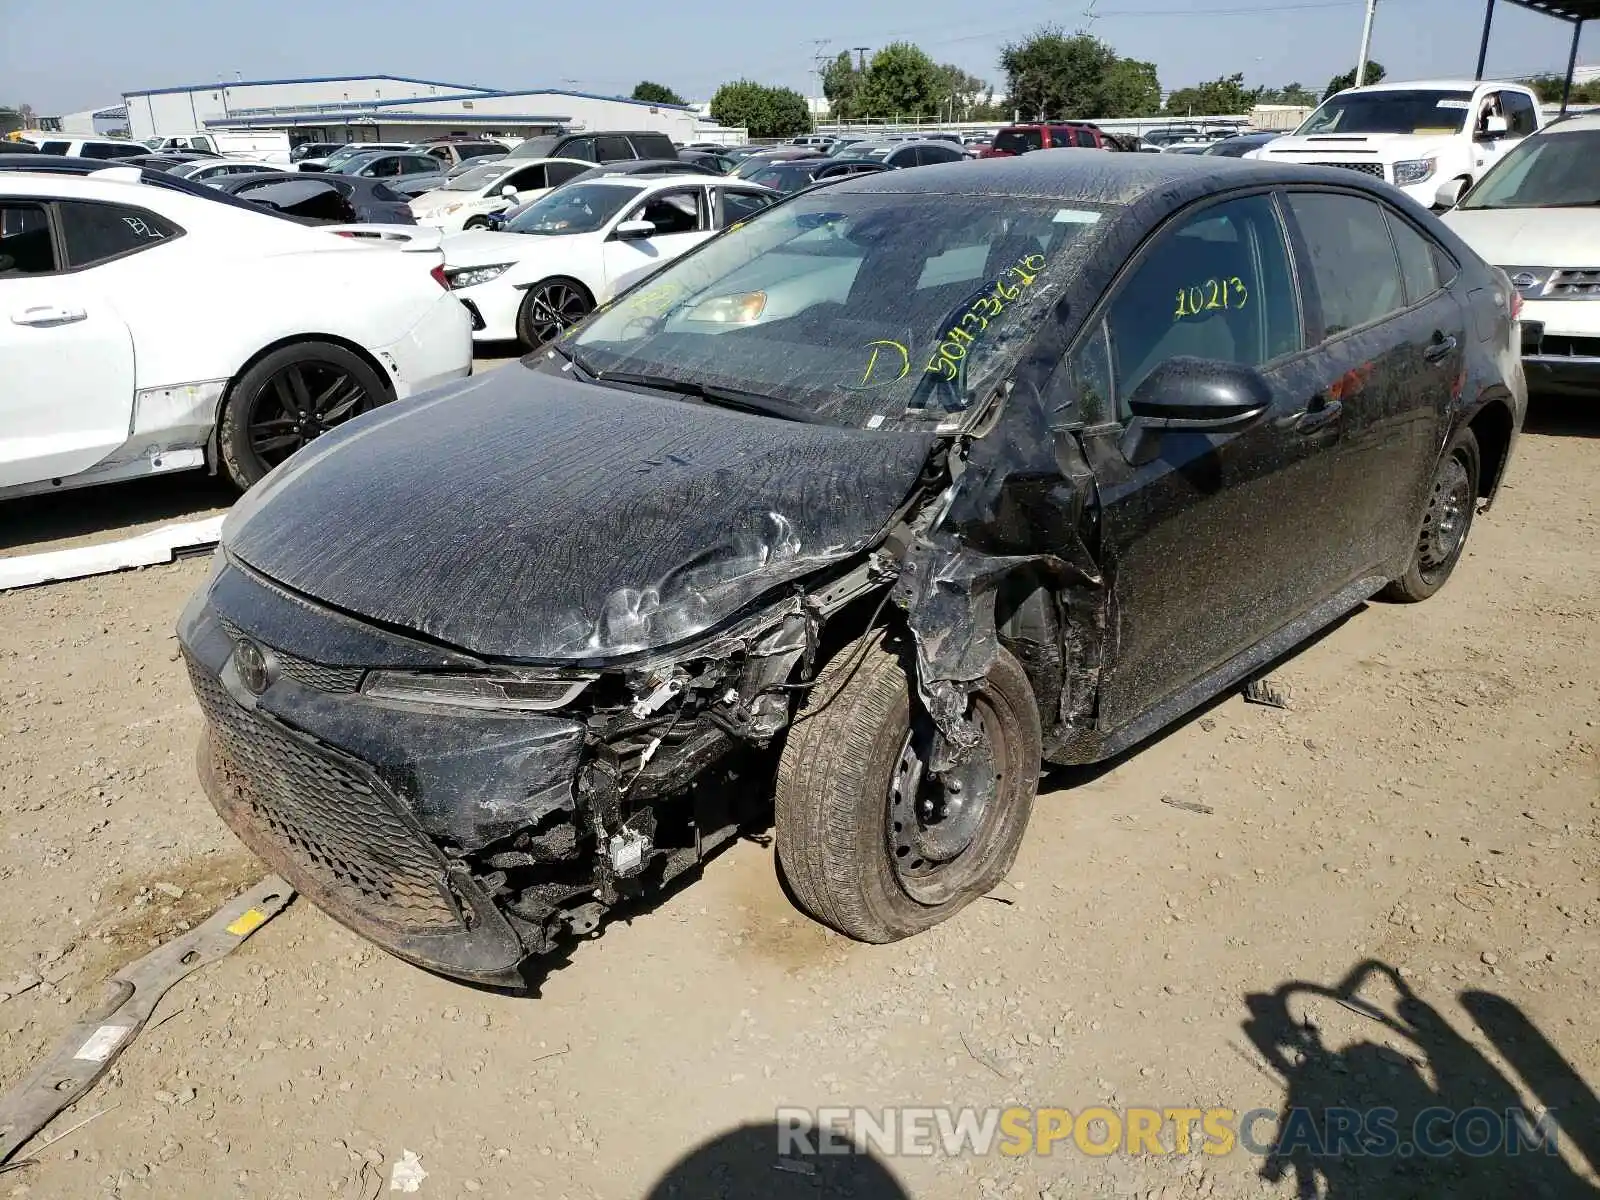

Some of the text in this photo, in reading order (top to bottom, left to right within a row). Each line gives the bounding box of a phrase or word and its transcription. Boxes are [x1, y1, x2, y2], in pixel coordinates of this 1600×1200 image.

[924, 254, 1047, 381] 50433610
[1174, 277, 1248, 320] 10213
[862, 340, 910, 387] D
